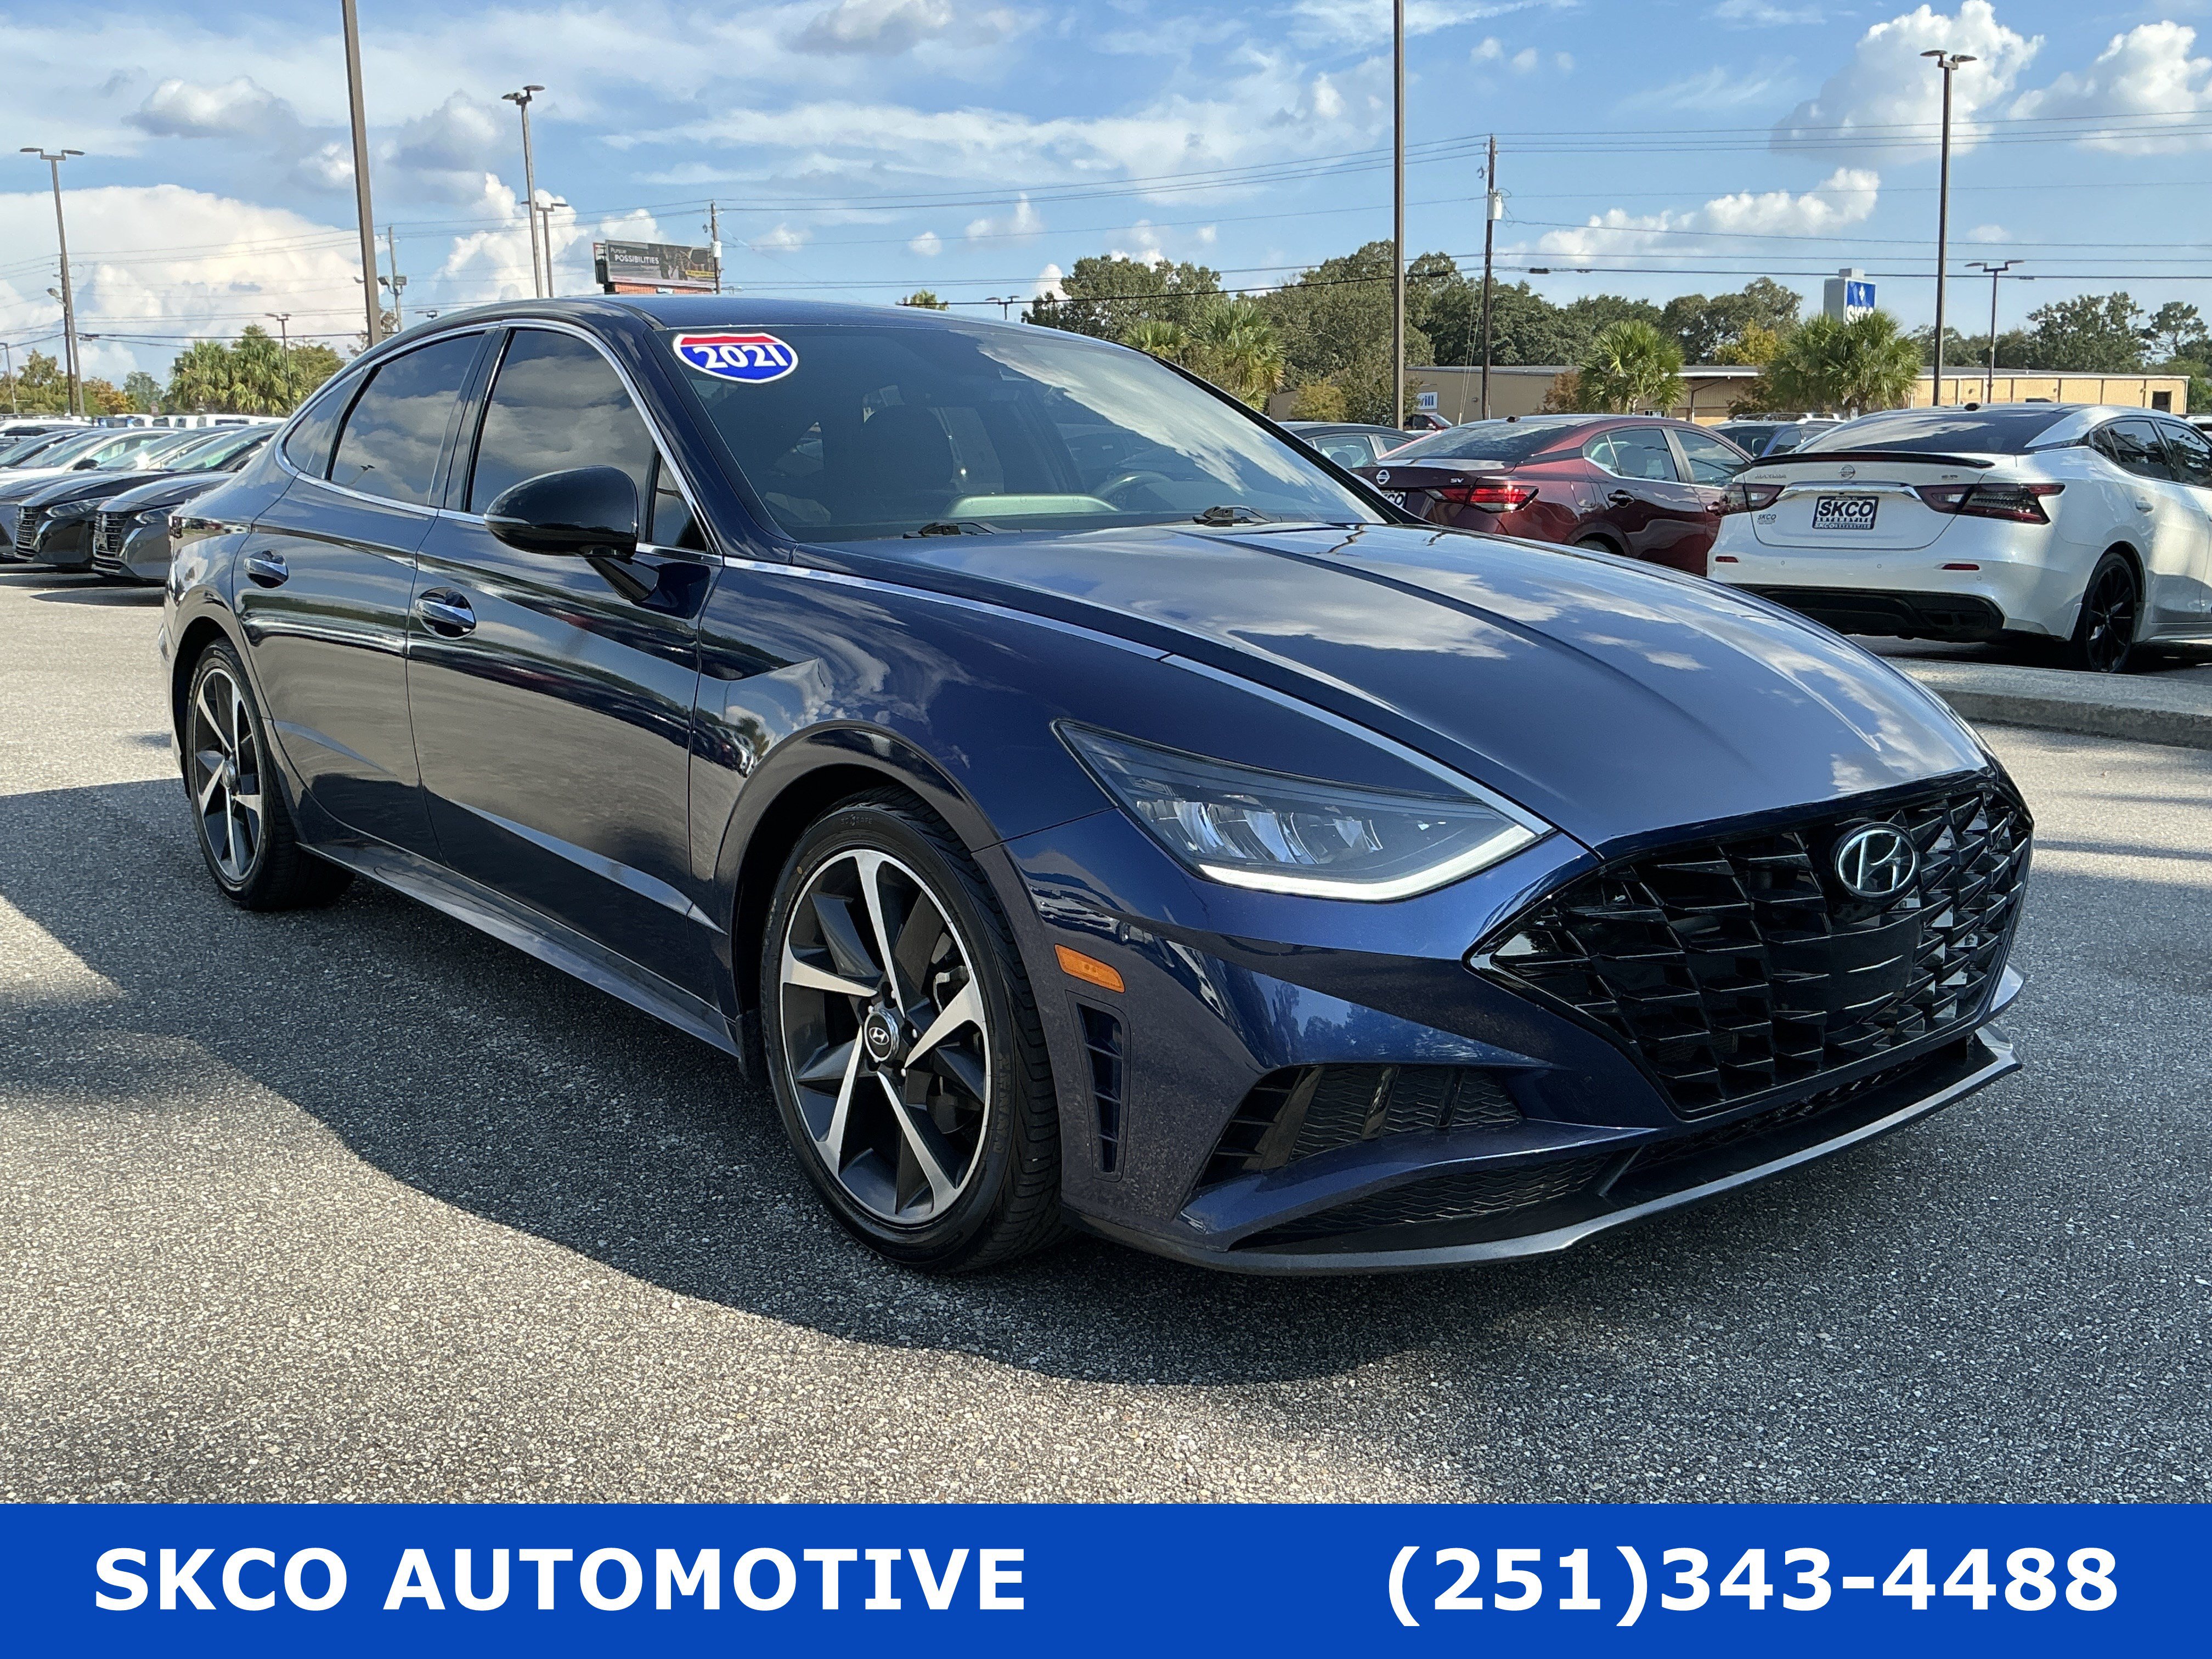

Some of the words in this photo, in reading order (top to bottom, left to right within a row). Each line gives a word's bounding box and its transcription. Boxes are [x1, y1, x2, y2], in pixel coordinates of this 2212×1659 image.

[614, 254, 659, 264] POSSIBILITIES
[692, 345, 788, 369] 2021
[1818, 501, 1874, 517] SKCO
